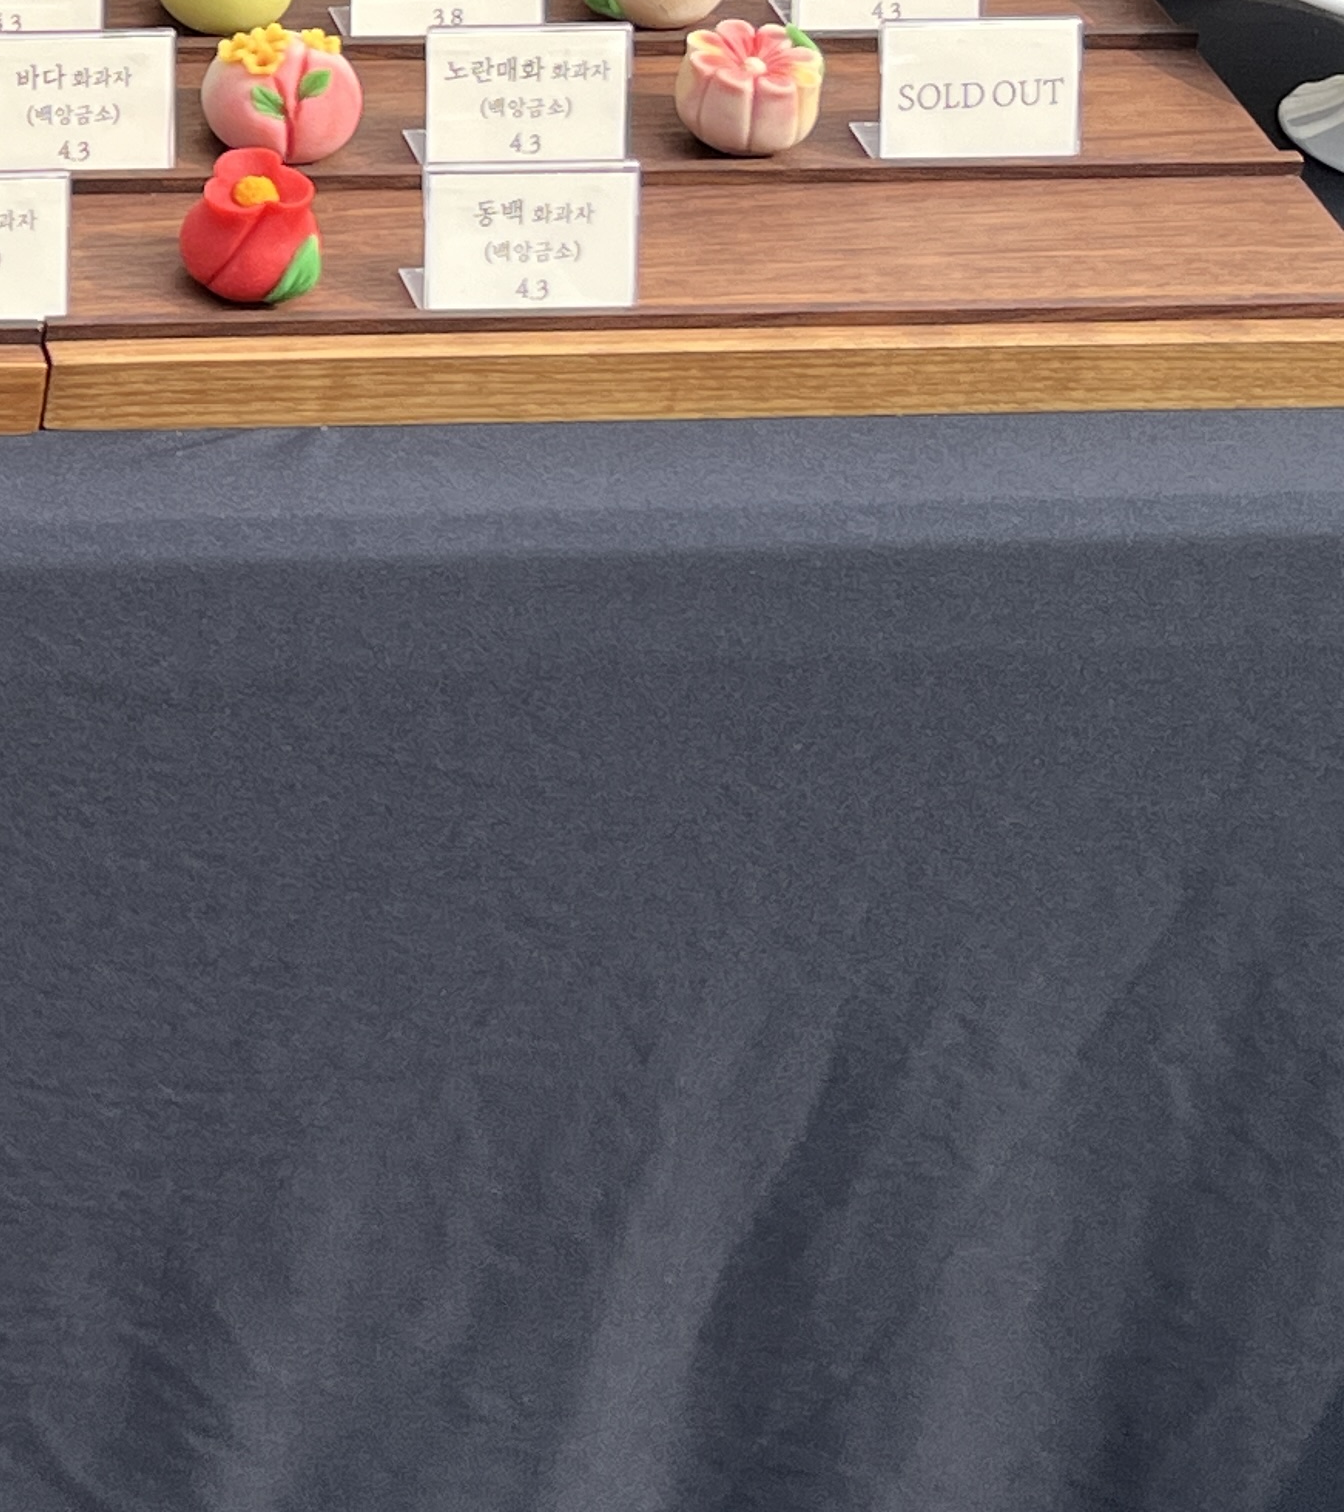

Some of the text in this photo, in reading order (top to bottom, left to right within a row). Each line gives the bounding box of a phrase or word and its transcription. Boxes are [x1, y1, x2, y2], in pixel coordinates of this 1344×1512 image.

[16, 64, 132, 90] 바다 화과자
[444, 56, 611, 83] 노란매화 화과자
[898, 77, 1065, 111] SOLD OUT
[58, 140, 90, 162] 4.3
[509, 132, 541, 155] 4.3
[473, 199, 596, 227] 동백 화과자
[515, 278, 549, 301] 4.3
